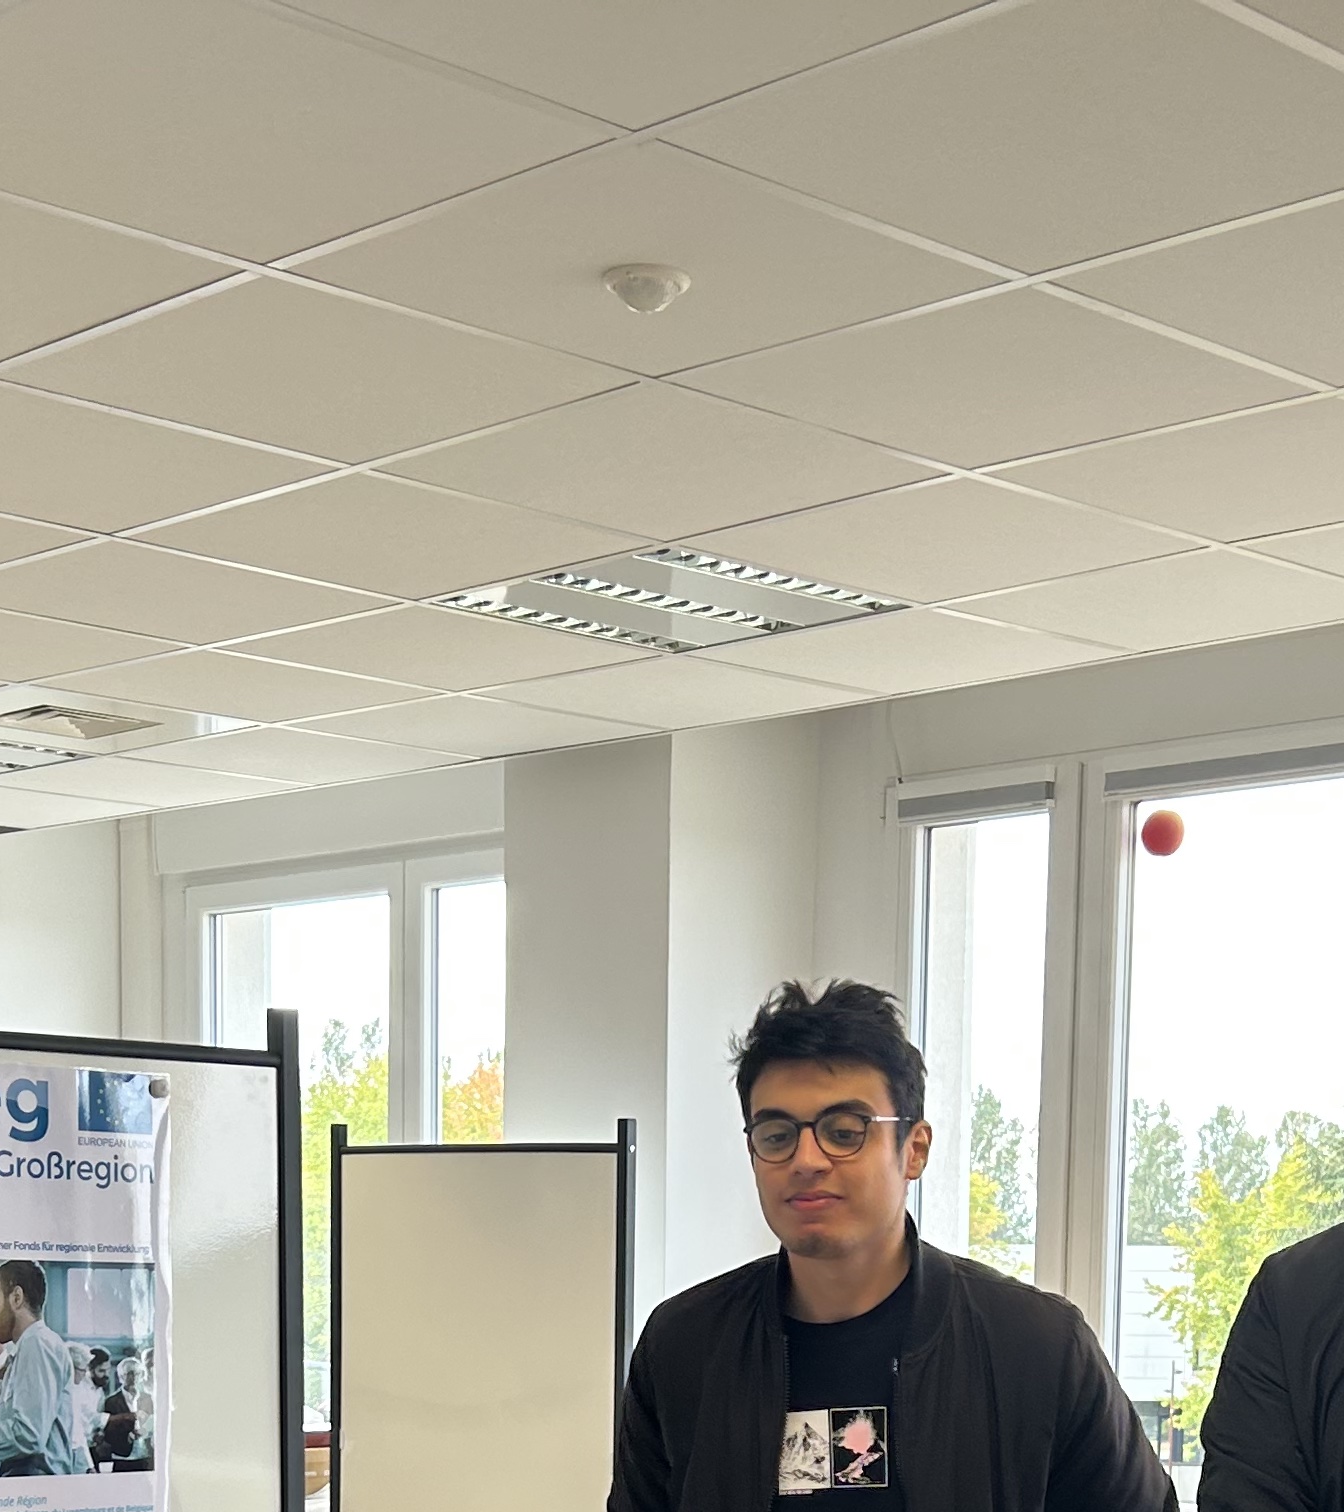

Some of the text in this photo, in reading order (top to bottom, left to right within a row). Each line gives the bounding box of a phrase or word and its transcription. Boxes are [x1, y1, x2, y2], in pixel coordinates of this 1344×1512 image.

[77, 1136, 126, 1149] EUROPEAN
[14, 1240, 41, 1251] Fonds
[42, 1240, 55, 1252] für
[56, 1242, 95, 1254] regionale
[16, 1494, 47, 1508] Région
[116, 1504, 125, 1512] de
